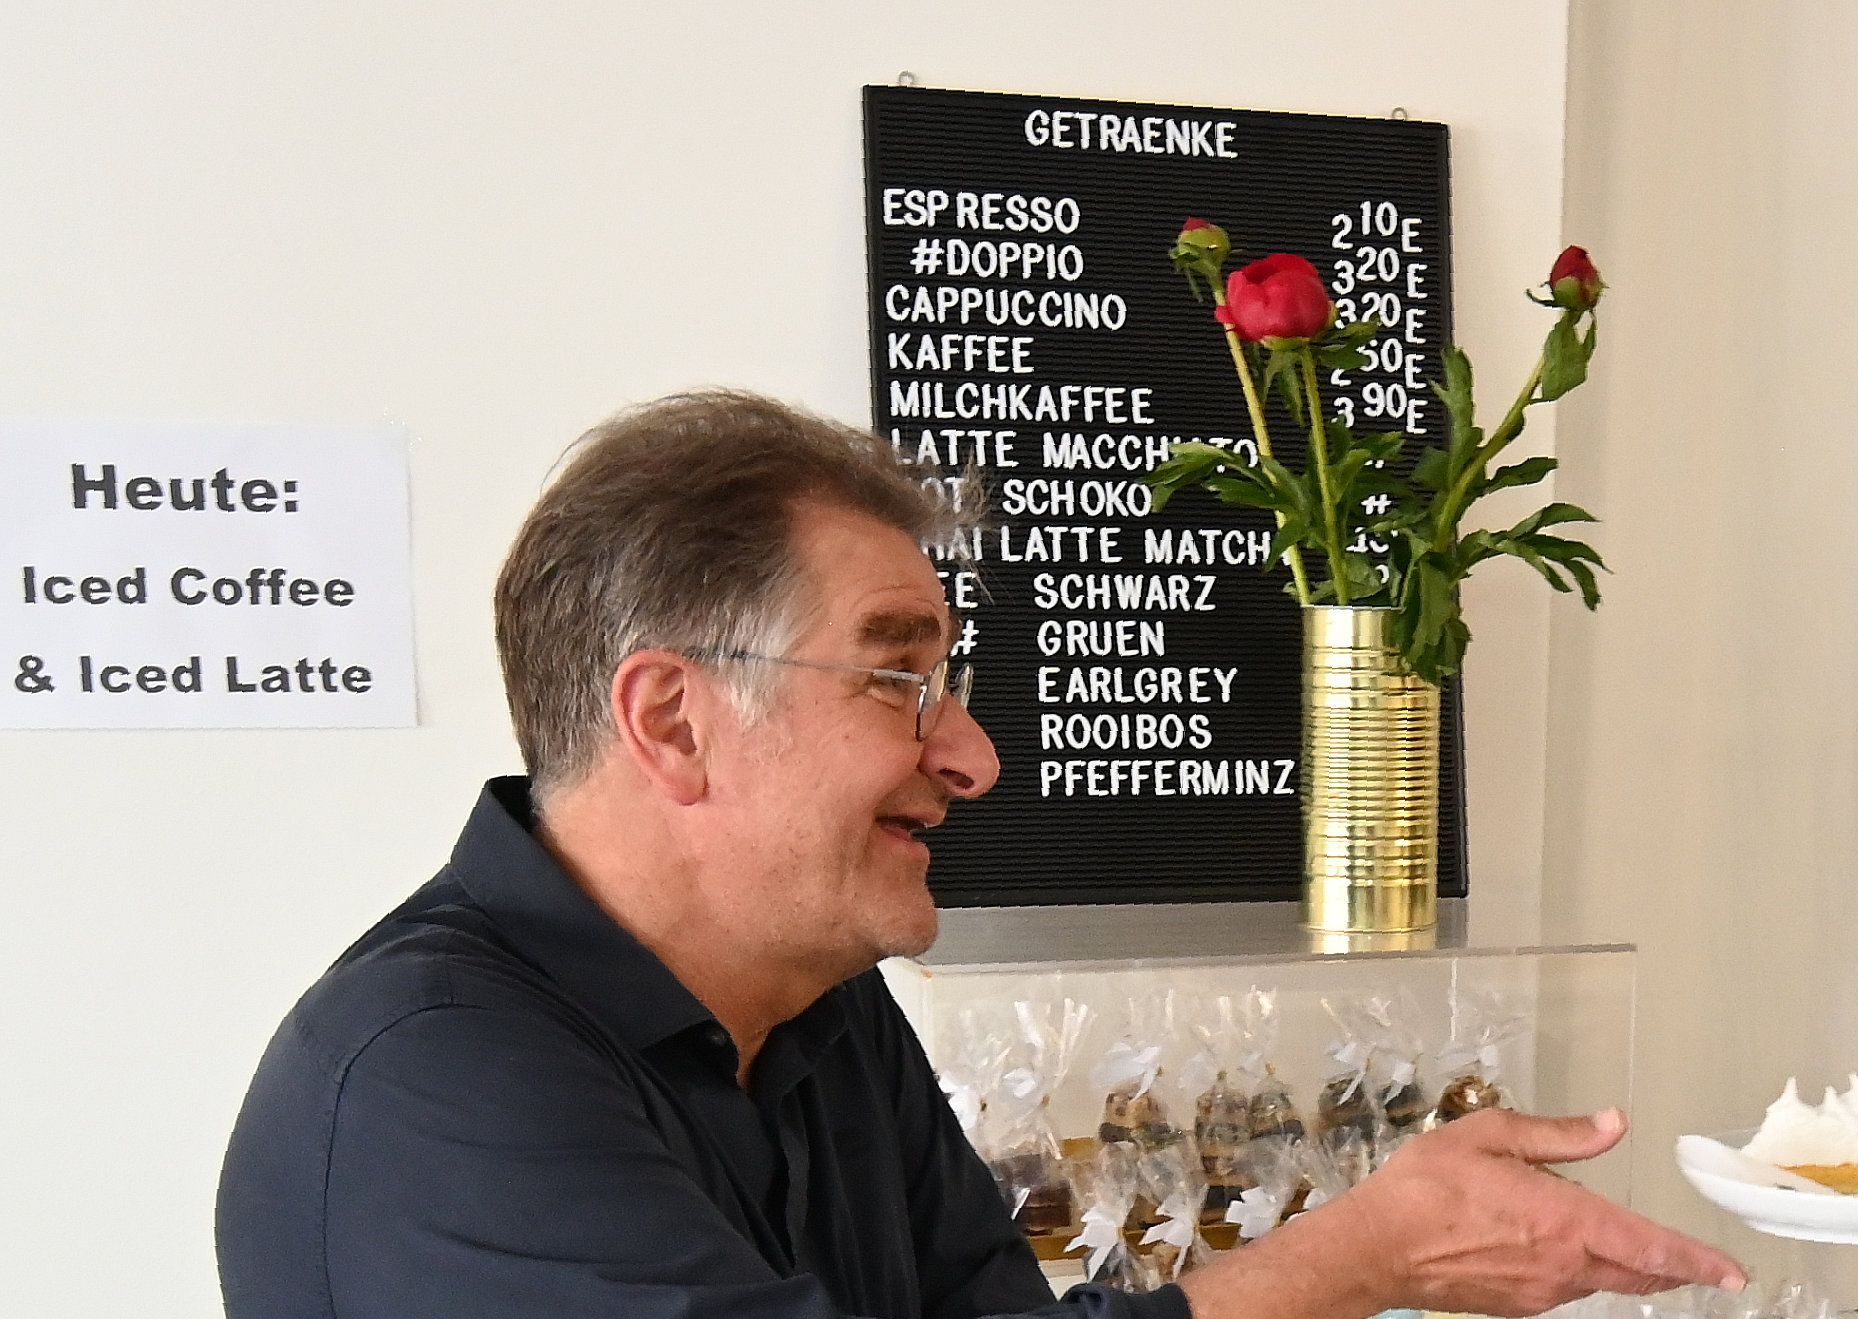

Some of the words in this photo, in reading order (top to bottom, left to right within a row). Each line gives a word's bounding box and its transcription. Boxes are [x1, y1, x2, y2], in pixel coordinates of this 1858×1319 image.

[1025, 109, 1239, 159] GETRAENKE
[882, 188, 1081, 234] ESPRESSO
[885, 285, 1127, 332] CAPPUCCINO
[888, 332, 1035, 374] KAFFEE
[889, 380, 1155, 425] MILCHKAFFEE
[890, 428, 1019, 468] LATTE
[1042, 431, 1260, 474] MACCHTO
[70, 463, 300, 513] Heute:
[1002, 478, 1152, 517] SCHOKO
[1001, 525, 1123, 563] LATTE
[1144, 528, 1292, 567] MATCH
[22, 566, 148, 605] Iced
[170, 566, 356, 607] Coffee
[1033, 572, 1217, 611] SCHWARZ
[1036, 620, 1166, 657] GRUEN
[14, 655, 56, 694] &
[79, 655, 202, 694] Iced
[225, 655, 373, 694] Latte
[1037, 666, 1238, 704] EARLGREY
[1041, 713, 1213, 750] ROOIBOS
[1040, 759, 1295, 797] PFEFFERMINZ
